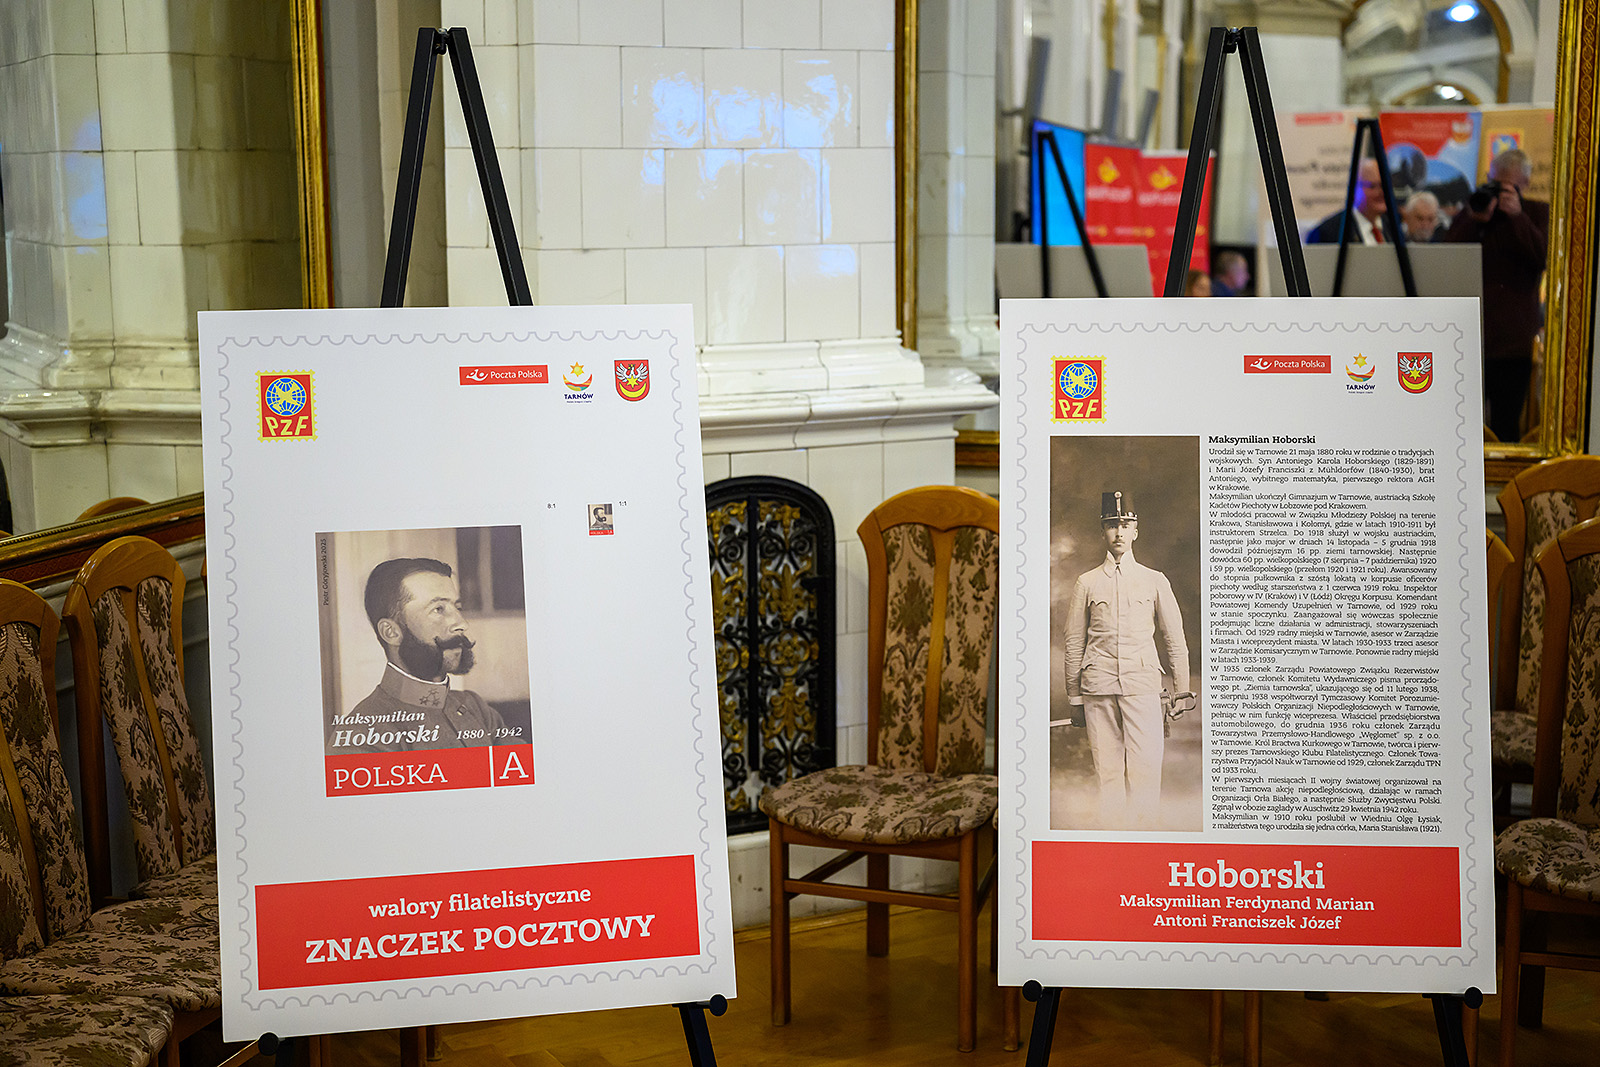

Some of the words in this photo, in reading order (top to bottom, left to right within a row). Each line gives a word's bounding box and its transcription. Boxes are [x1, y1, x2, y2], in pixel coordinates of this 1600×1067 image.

[1274, 360, 1300, 369] Poczta
[1301, 360, 1325, 368] Polska
[490, 370, 516, 380] Poczta
[518, 370, 542, 378] Polska
[1346, 382, 1376, 390] TARNÓW
[564, 392, 594, 400] TARNÓW
[1058, 398, 1100, 418] PZF
[265, 414, 311, 437] PZF
[1208, 435, 1270, 445] Maksymilian
[1272, 435, 1316, 443] Hoborski
[1236, 448, 1246, 457] się
[1298, 448, 1316, 457] maja
[1398, 448, 1435, 457] tradycjach
[1258, 457, 1272, 466] Syn
[1276, 457, 1313, 466] Antoniego
[1345, 457, 1390, 466] Hoborskiego
[1394, 457, 1435, 466] (1829-1891)
[1240, 466, 1264, 475] Józefy
[1252, 475, 1289, 484] wybitnego
[1342, 475, 1384, 484] pierwszego
[1209, 493, 1254, 502] Maksymilian
[1255, 493, 1287, 502] ukończył
[1288, 493, 1328, 502] Gimnazjum
[1412, 493, 1436, 502] Szkołę
[1223, 574, 1250, 583] stopnia
[1254, 574, 1296, 583] pułkownika
[1308, 575, 1330, 584] szóstą
[1334, 575, 1356, 584] lokatą
[1371, 575, 1402, 584] korpusie
[1210, 601, 1250, 610] Powiatowej
[1254, 601, 1289, 610] Komendy
[1421, 602, 1438, 610] roku
[1210, 619, 1251, 628] podejmując
[1275, 666, 1305, 675] Zarządu
[1309, 666, 1356, 675] Powiatowego
[1360, 666, 1390, 675] Związku
[1220, 692, 1249, 701] sierpniu
[1321, 694, 1366, 702] Tymczasowy
[1210, 703, 1239, 711] wawczy
[1274, 702, 1314, 711] Organizacji
[332, 710, 426, 727] Maksymilian
[1295, 721, 1325, 730] grudnia
[1408, 722, 1441, 731] Zarządu
[332, 724, 440, 748] Hoborski
[456, 728, 485, 741] 1880
[494, 726, 523, 739] 1942
[1225, 749, 1249, 757] prezes
[1250, 748, 1300, 757] Tarnowskiego
[333, 762, 448, 790] POLSKA
[498, 752, 529, 780] A
[1224, 776, 1264, 785] pierwszych
[1268, 776, 1307, 785] miesiącach
[1320, 777, 1342, 786] wojny
[1345, 777, 1381, 786] światowej
[1384, 778, 1429, 787] organizował
[1212, 813, 1259, 822] Maksymilian
[1396, 815, 1414, 824] Olgę
[1168, 860, 1325, 890] Hoborski
[369, 896, 443, 921] walory
[448, 886, 592, 914] filatelistyczne
[1119, 894, 1221, 912] Maksymilian
[1226, 895, 1311, 914] Ferdynand
[1316, 897, 1375, 911] Marian
[1153, 913, 1207, 928] Antoni
[1212, 914, 1296, 929] Franciszek
[1300, 914, 1342, 932] Józef
[305, 928, 465, 964] ZNACZEK
[473, 914, 655, 951] POCZTOWY
